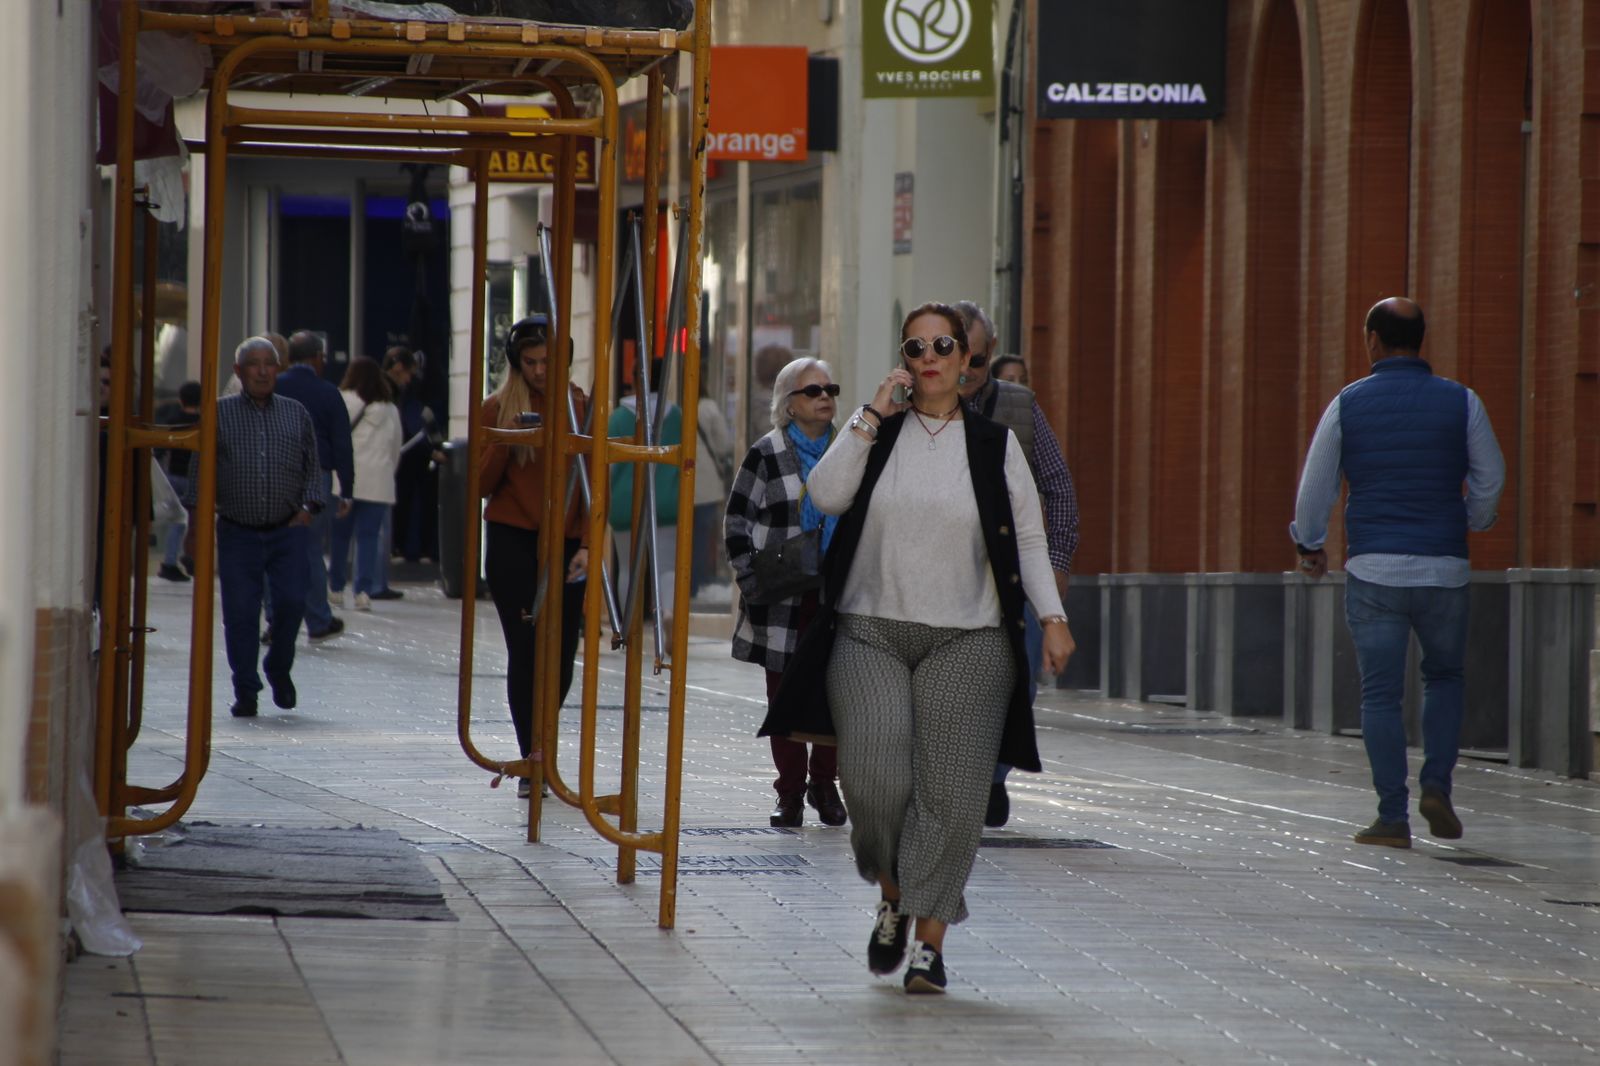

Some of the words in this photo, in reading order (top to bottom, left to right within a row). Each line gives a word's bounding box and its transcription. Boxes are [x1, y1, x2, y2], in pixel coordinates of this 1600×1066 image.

[876, 71, 914, 83] YVES
[918, 70, 982, 82] ROCHER
[1047, 82, 1207, 103] CALZEDONIA
[706, 132, 797, 159] orange
